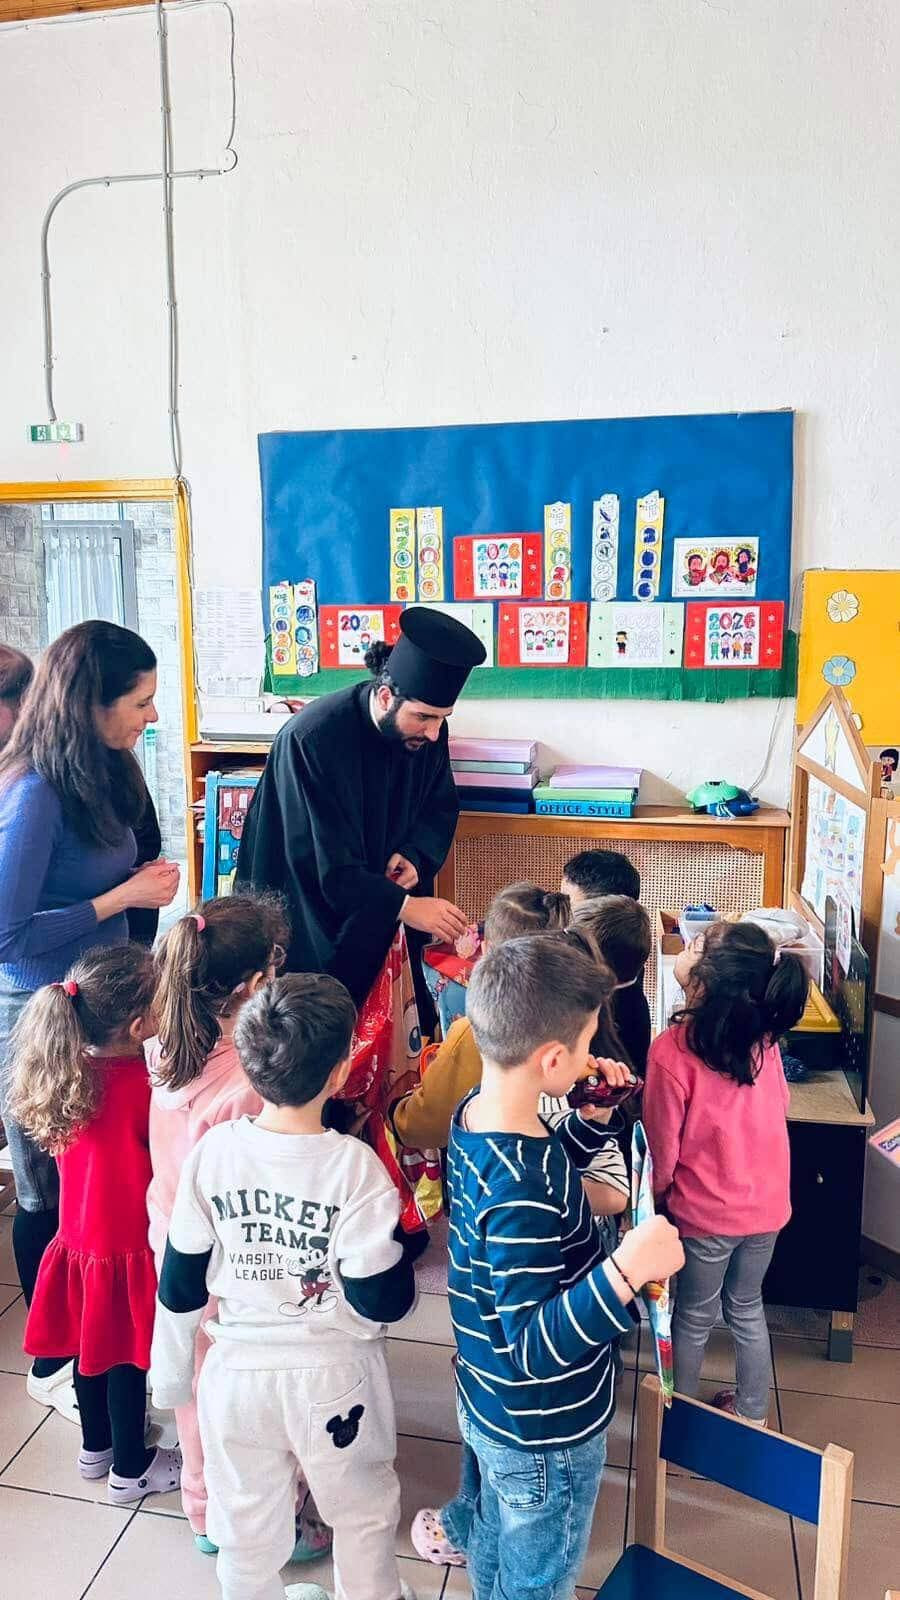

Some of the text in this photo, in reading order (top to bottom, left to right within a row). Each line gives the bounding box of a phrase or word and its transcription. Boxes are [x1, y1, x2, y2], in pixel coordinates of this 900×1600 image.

[477, 542, 520, 560] 2026
[523, 611, 566, 627] 2026
[709, 611, 756, 630] 2026
[540, 804, 625, 815] OFFICE STYLE
[211, 1189, 340, 1232] MICKEY
[242, 1222, 308, 1250] TEAM
[229, 1252, 284, 1265] VARSITY
[235, 1268, 284, 1281] LEAGUE
